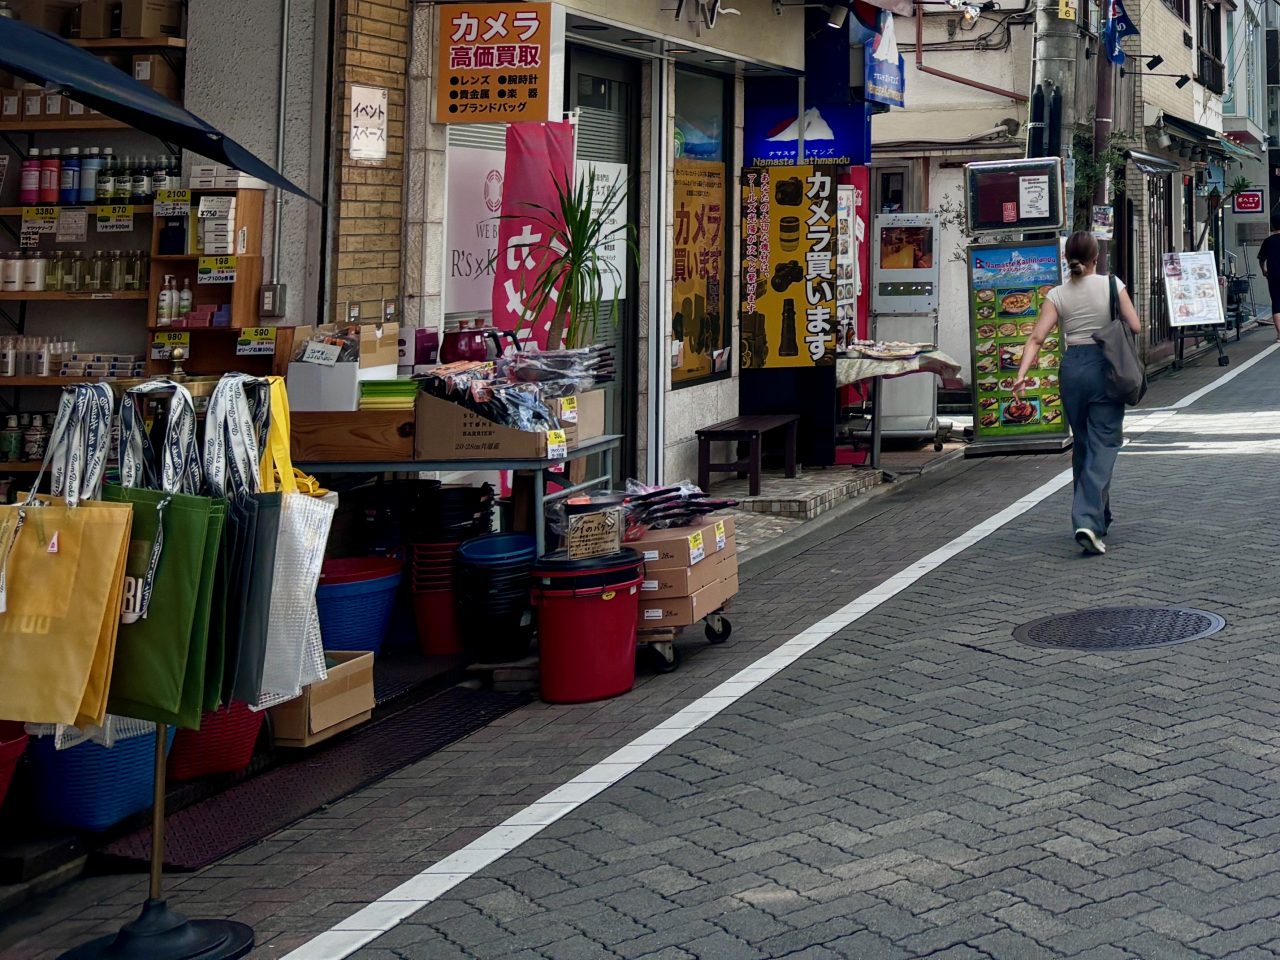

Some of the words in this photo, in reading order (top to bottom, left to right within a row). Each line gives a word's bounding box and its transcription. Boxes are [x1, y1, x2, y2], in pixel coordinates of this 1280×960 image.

[449, 10, 541, 43] カメラ
[449, 45, 541, 69] 高価買取
[461, 75, 490, 85] レンズ
[508, 74, 538, 84] 腕時計
[460, 89, 490, 99] 貴金属
[353, 103, 385, 121] イベント
[459, 102, 527, 113] ブランドバッグ
[353, 125, 385, 142] スペース
[769, 148, 834, 156] ナマステトマンズ
[753, 158, 794, 166] Namaste
[797, 156, 850, 165] athmandu
[167, 190, 187, 198] 2100
[675, 201, 722, 246] カメラ
[214, 257, 229, 265] 198
[804, 172, 832, 362] カメラ買います
[253, 328, 269, 337] 590
